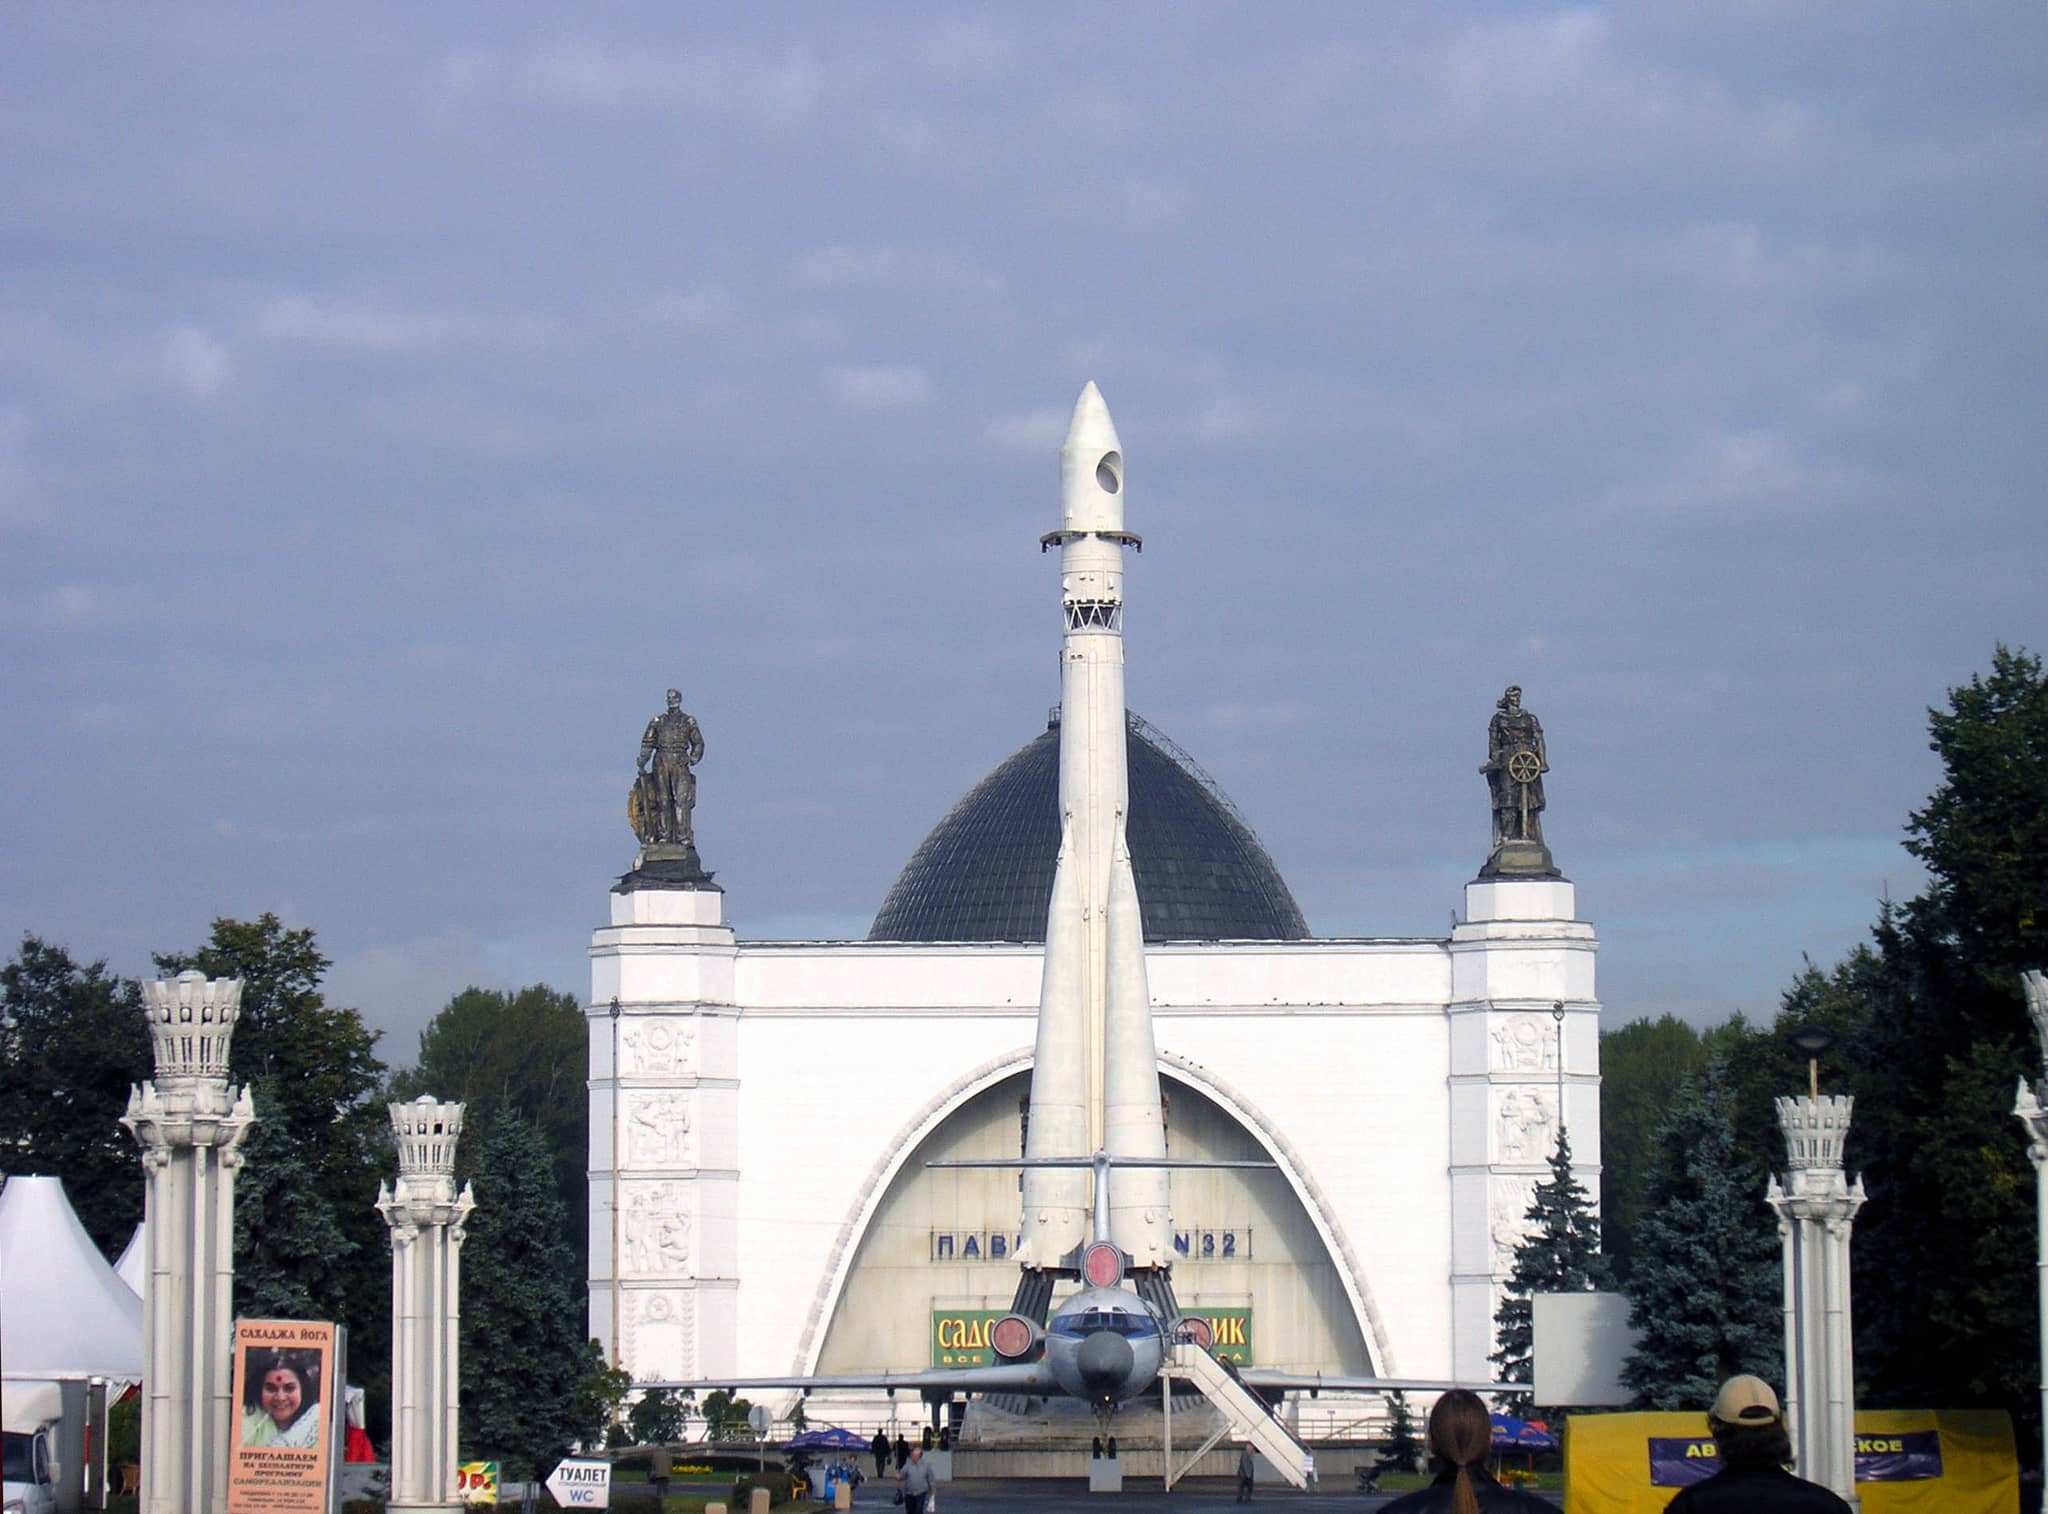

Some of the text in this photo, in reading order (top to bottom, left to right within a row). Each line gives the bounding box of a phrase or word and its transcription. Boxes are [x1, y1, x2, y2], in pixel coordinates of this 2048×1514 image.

[938, 1235, 1020, 1258] ПАВ
[240, 1328, 328, 1341] САХАДЖА ЙОГА
[240, 1452, 318, 1462] ПРИГЛАШАЕМ
[559, 1467, 607, 1482] ТУАЛЕТ
[570, 1490, 594, 1502] WC
